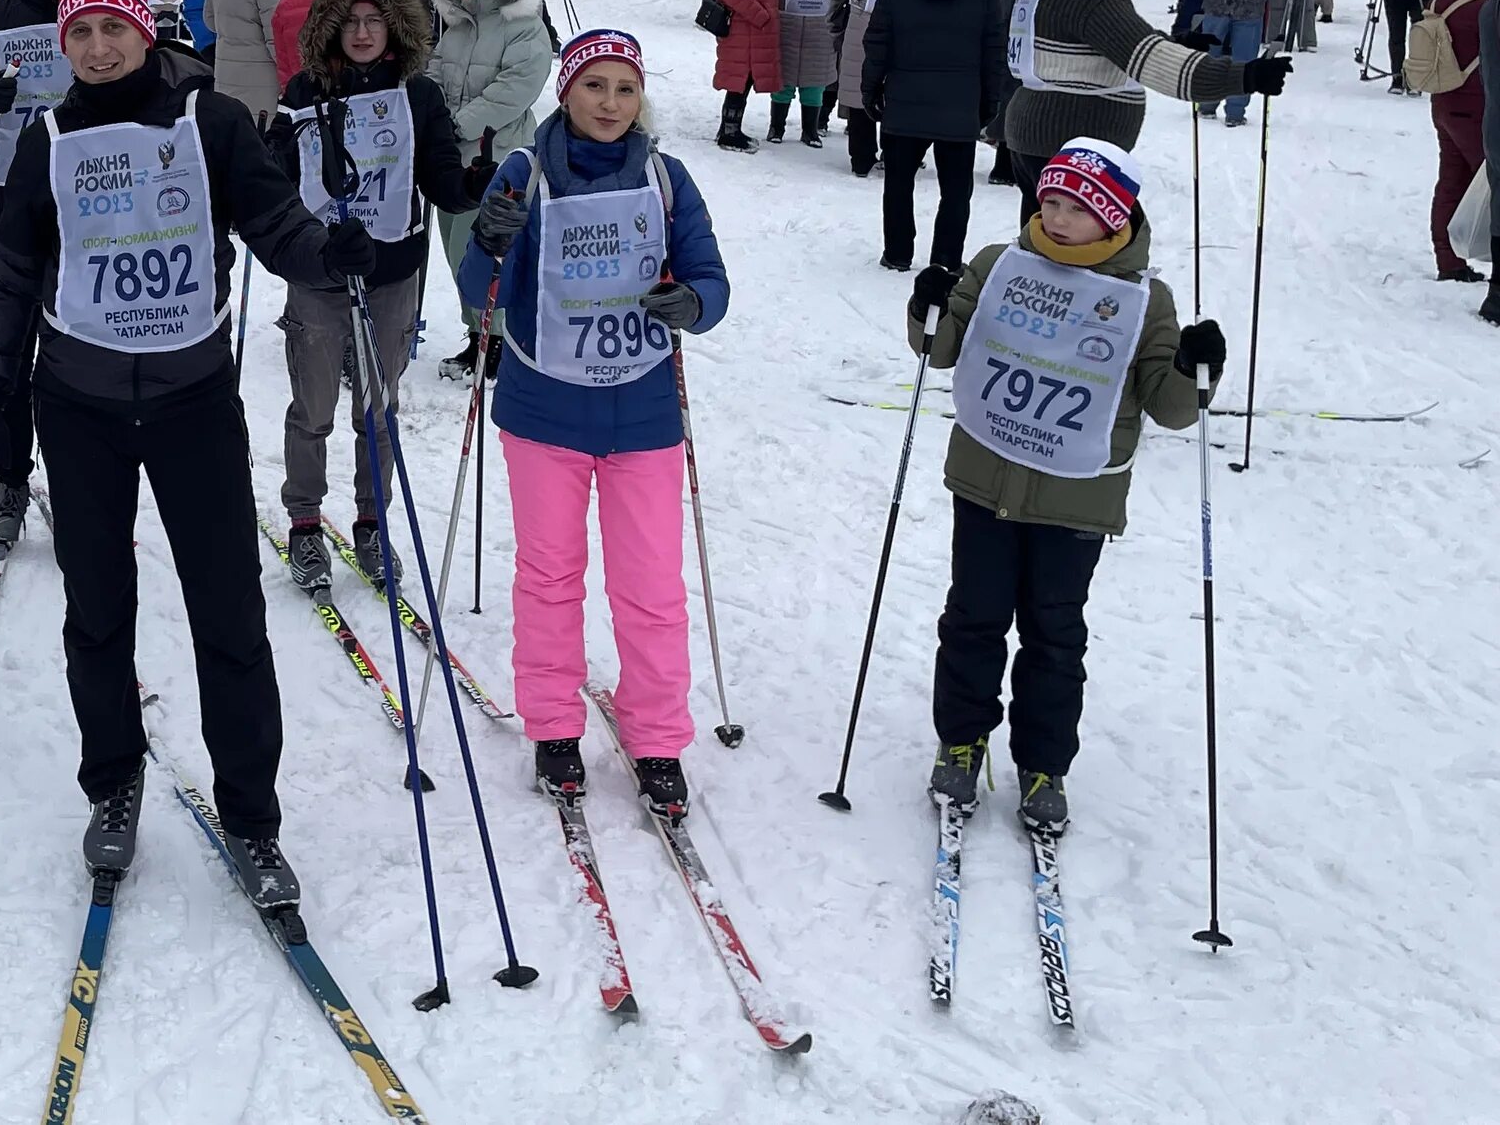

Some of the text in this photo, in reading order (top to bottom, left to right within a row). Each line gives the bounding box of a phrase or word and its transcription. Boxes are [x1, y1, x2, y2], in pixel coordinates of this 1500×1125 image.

[3, 38, 53, 52] ЛЫЖНЯ
[4, 50, 54, 65] РОССИИ
[18, 65, 53, 78] 023
[561, 223, 619, 244] ЛЫЖНЯ
[562, 239, 621, 260] РОССИИ
[87, 243, 199, 304] 7892
[562, 259, 621, 280] 2023
[1002, 286, 1068, 322] РОССИИ
[1006, 276, 1075, 306] ЛЫЖНЯ
[105, 304, 190, 324] РЕСПУБЛИКА
[994, 305, 1059, 340] 2023
[113, 321, 184, 339] ТАТАРСТАН
[568, 311, 669, 359] 7896
[980, 356, 1091, 431] 7972
[986, 411, 1064, 447] РЕСПУБЛИКА
[990, 426, 1054, 458] ТАТАРСТАН
[72, 956, 99, 1005] XC
[76, 1017, 89, 1048] COMBI
[47, 1055, 77, 1125] NORD
